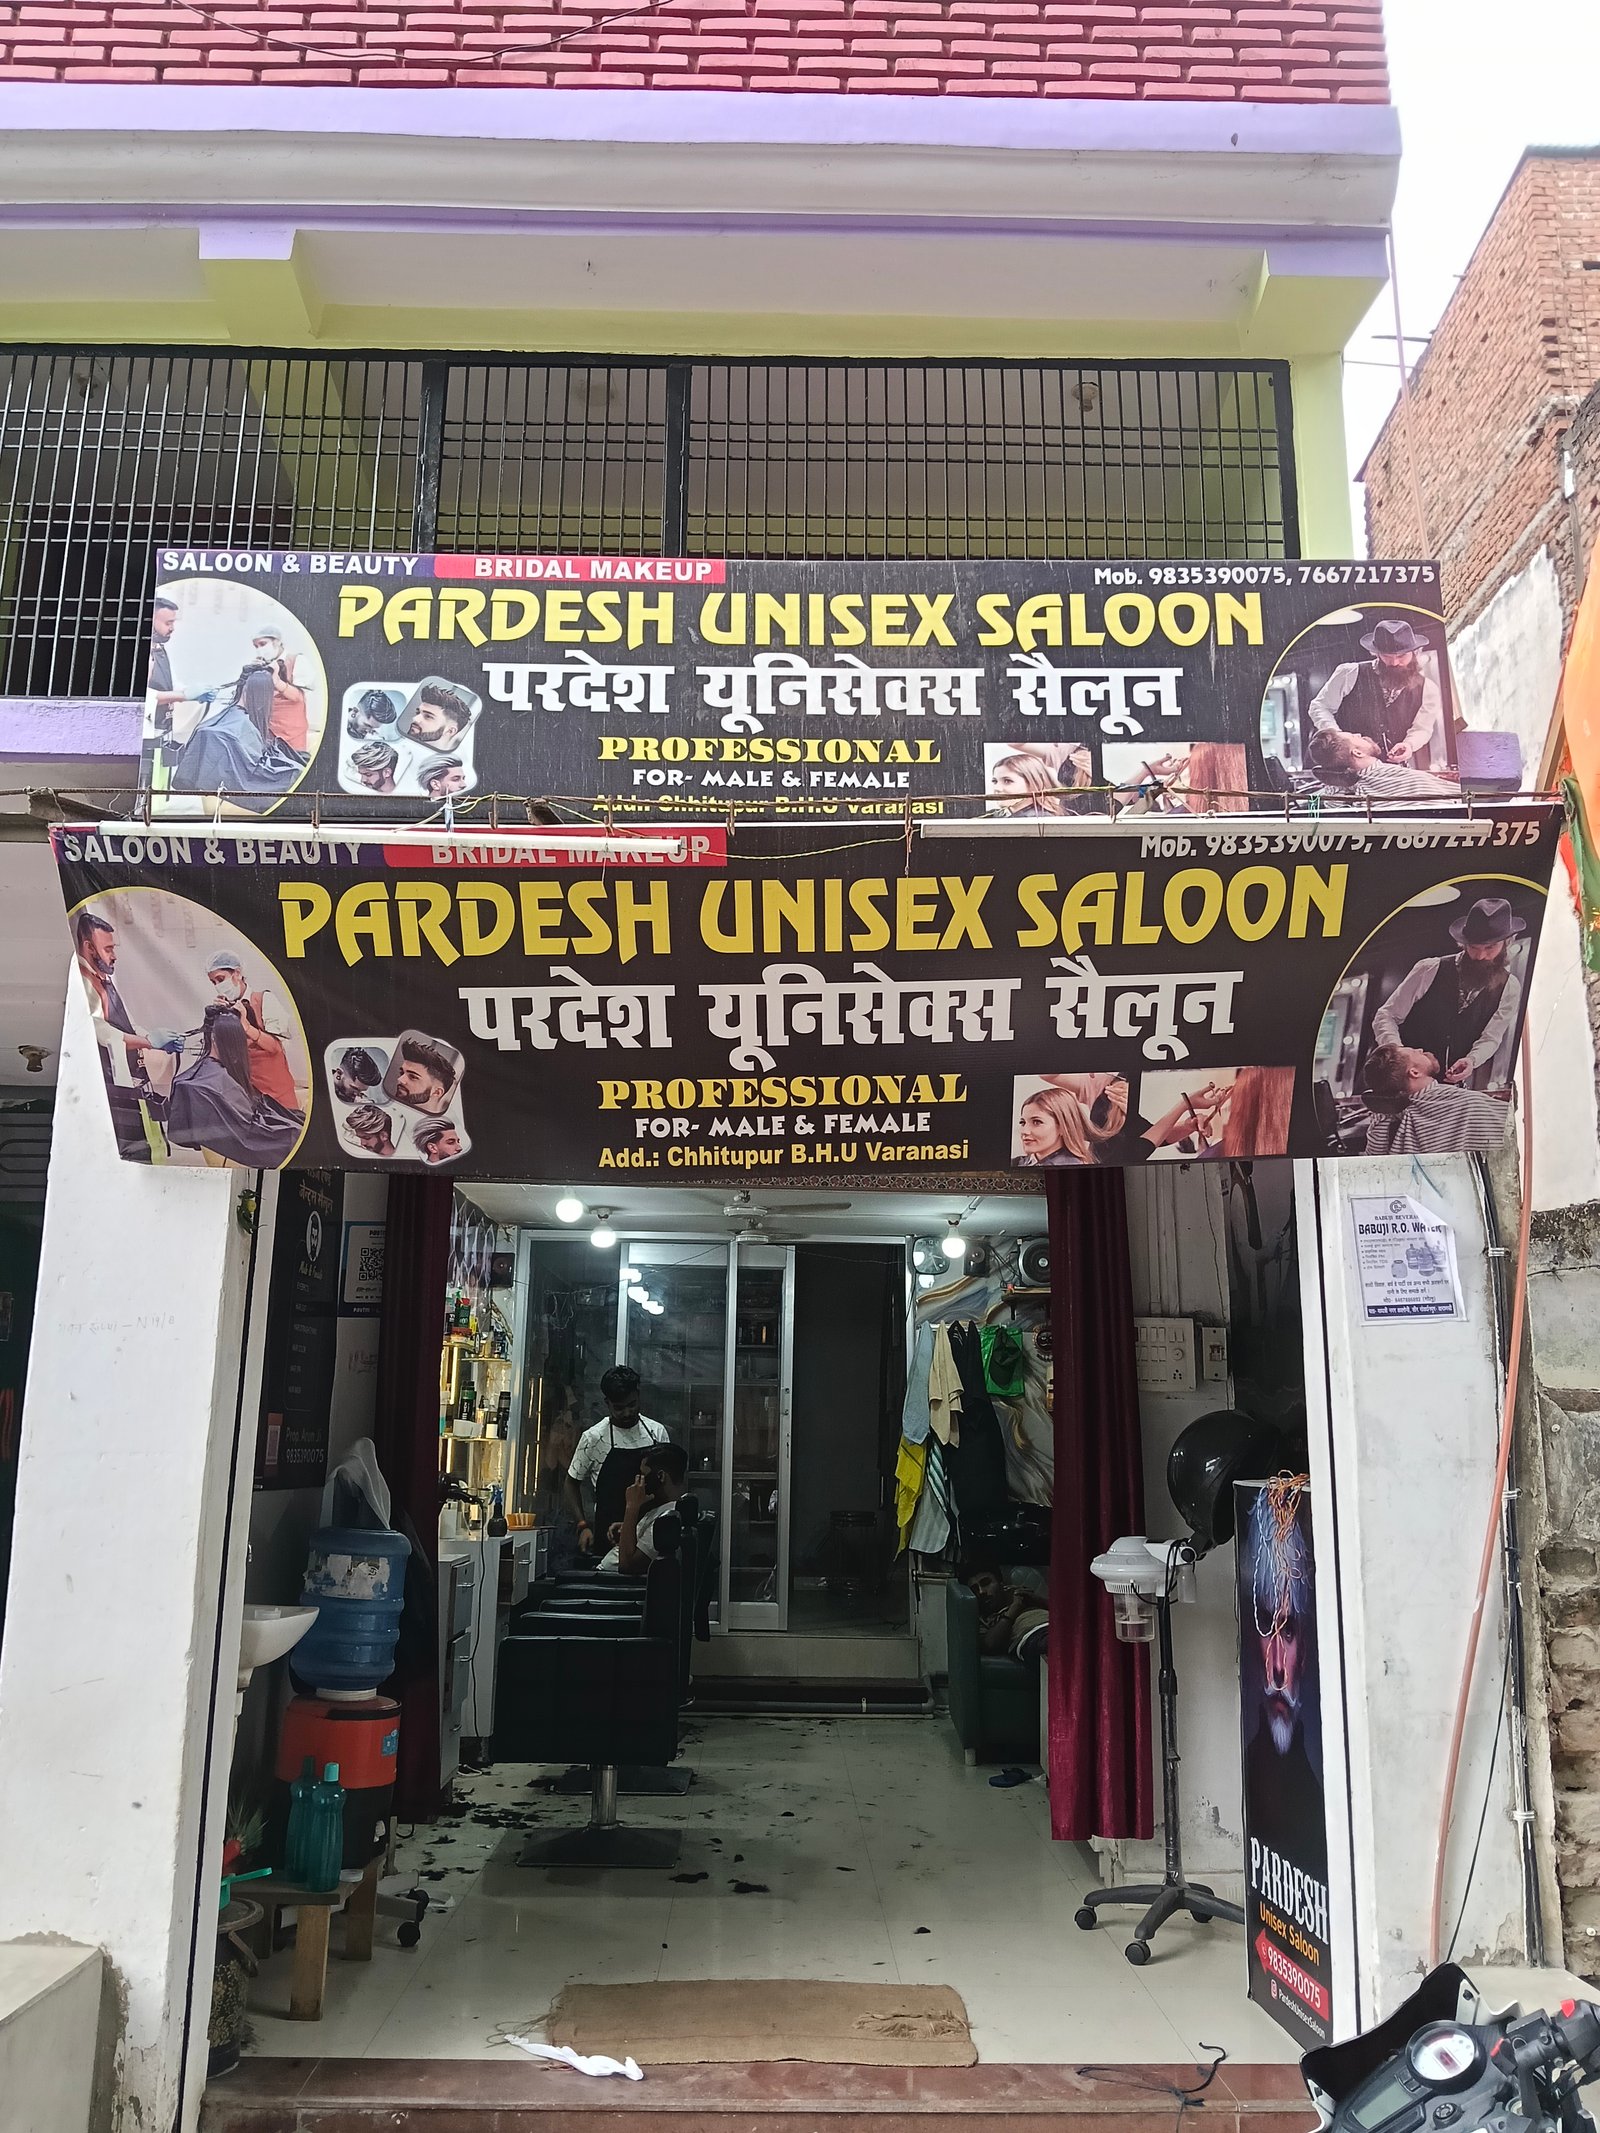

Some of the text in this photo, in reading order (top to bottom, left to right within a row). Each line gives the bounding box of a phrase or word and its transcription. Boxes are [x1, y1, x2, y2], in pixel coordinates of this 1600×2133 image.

[164, 551, 418, 577] SALOON & BEAUTY
[474, 557, 712, 582] BRIDAL MAKEUP
[1095, 566, 1434, 585] Mob. 9835390075, 7667217375
[339, 585, 1263, 652] PARDESH UNISEX SALOON
[483, 650, 1183, 735] परदेश यूनिसेक्स सैलून
[598, 737, 940, 763] PROFESSIONAL
[633, 769, 909, 788] FOR- MALE & FEMALE
[64, 833, 361, 865] SALOON & BEAUTY
[432, 845, 556, 863] BRIDAL
[1141, 836, 1196, 858] Mob.
[1205, 834, 1371, 856] 9835390075,
[278, 864, 1348, 966] PARDESH UNISEX SALOON
[459, 955, 1243, 1072] परदेश यूनिसेक्स सैलून
[597, 1074, 966, 1109] PROFESSIONAL
[636, 1112, 930, 1137] FOR- MALE & FEMALE
[599, 1142, 968, 1169] Add.: Chhitupur B.H.U Varanasi
[1358, 1223, 1389, 1236] BABUJI
[1392, 1223, 1410, 1234] R.O.
[1251, 1836, 1329, 1945] PARDESH
[1260, 1901, 1320, 1966] Unisex Saloon
[1268, 1945, 1322, 2009] 9835390075
